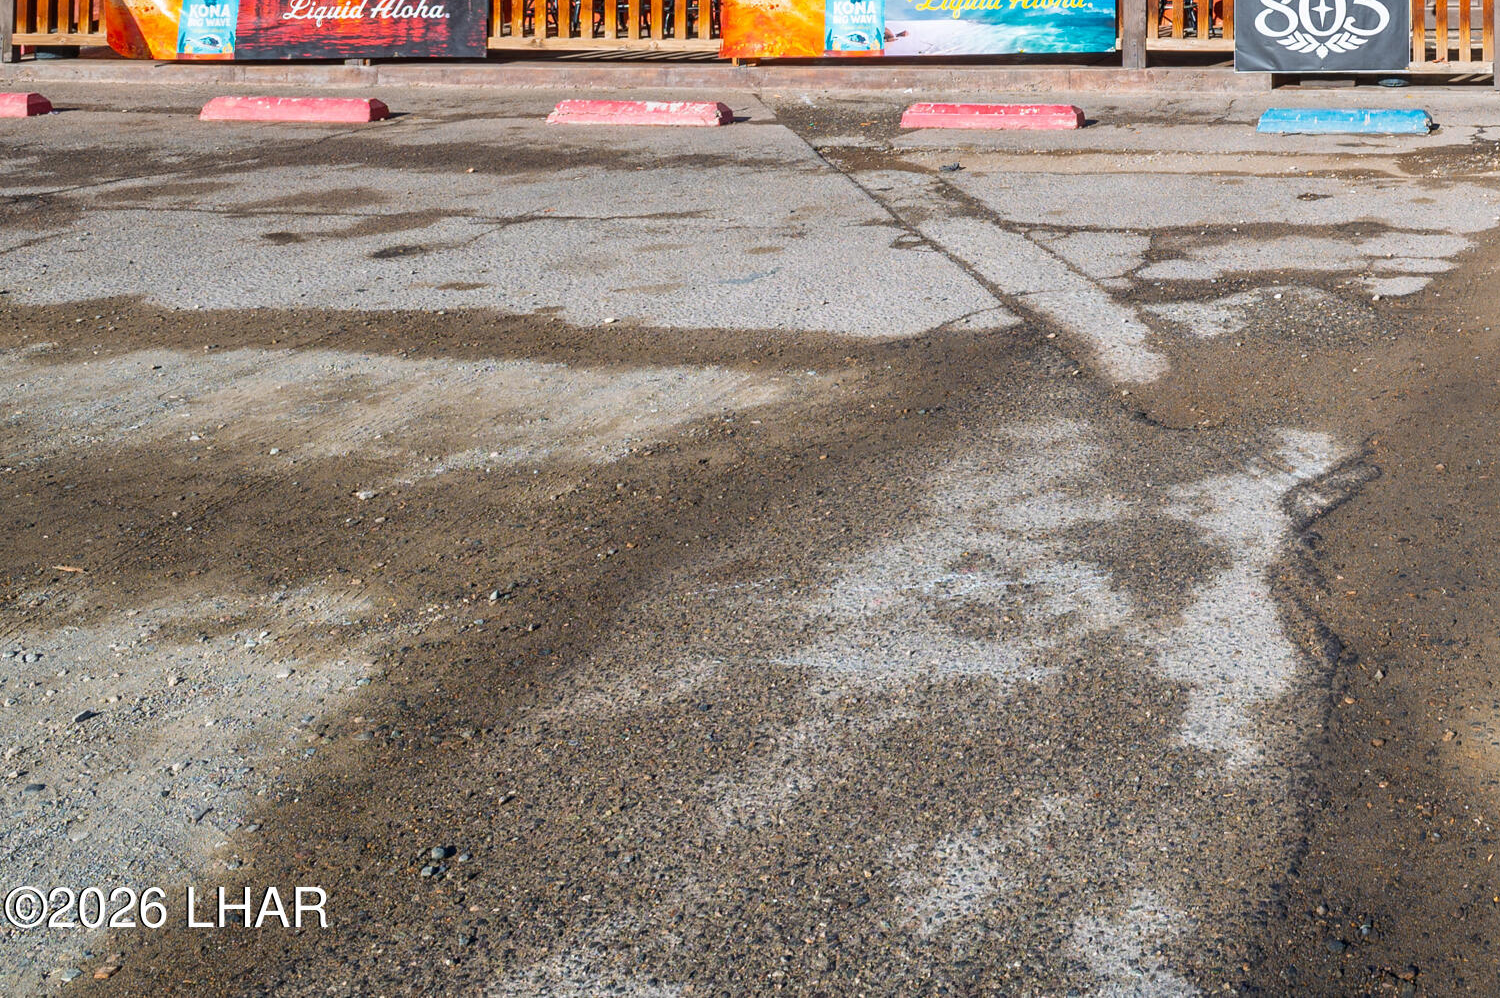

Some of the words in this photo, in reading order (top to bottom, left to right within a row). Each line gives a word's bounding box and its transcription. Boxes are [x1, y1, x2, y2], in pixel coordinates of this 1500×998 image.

[190, 3, 231, 19] KONA
[833, 0, 877, 16] KONA
[206, 17, 231, 27] WAVE
[850, 14, 878, 25] WAVE
